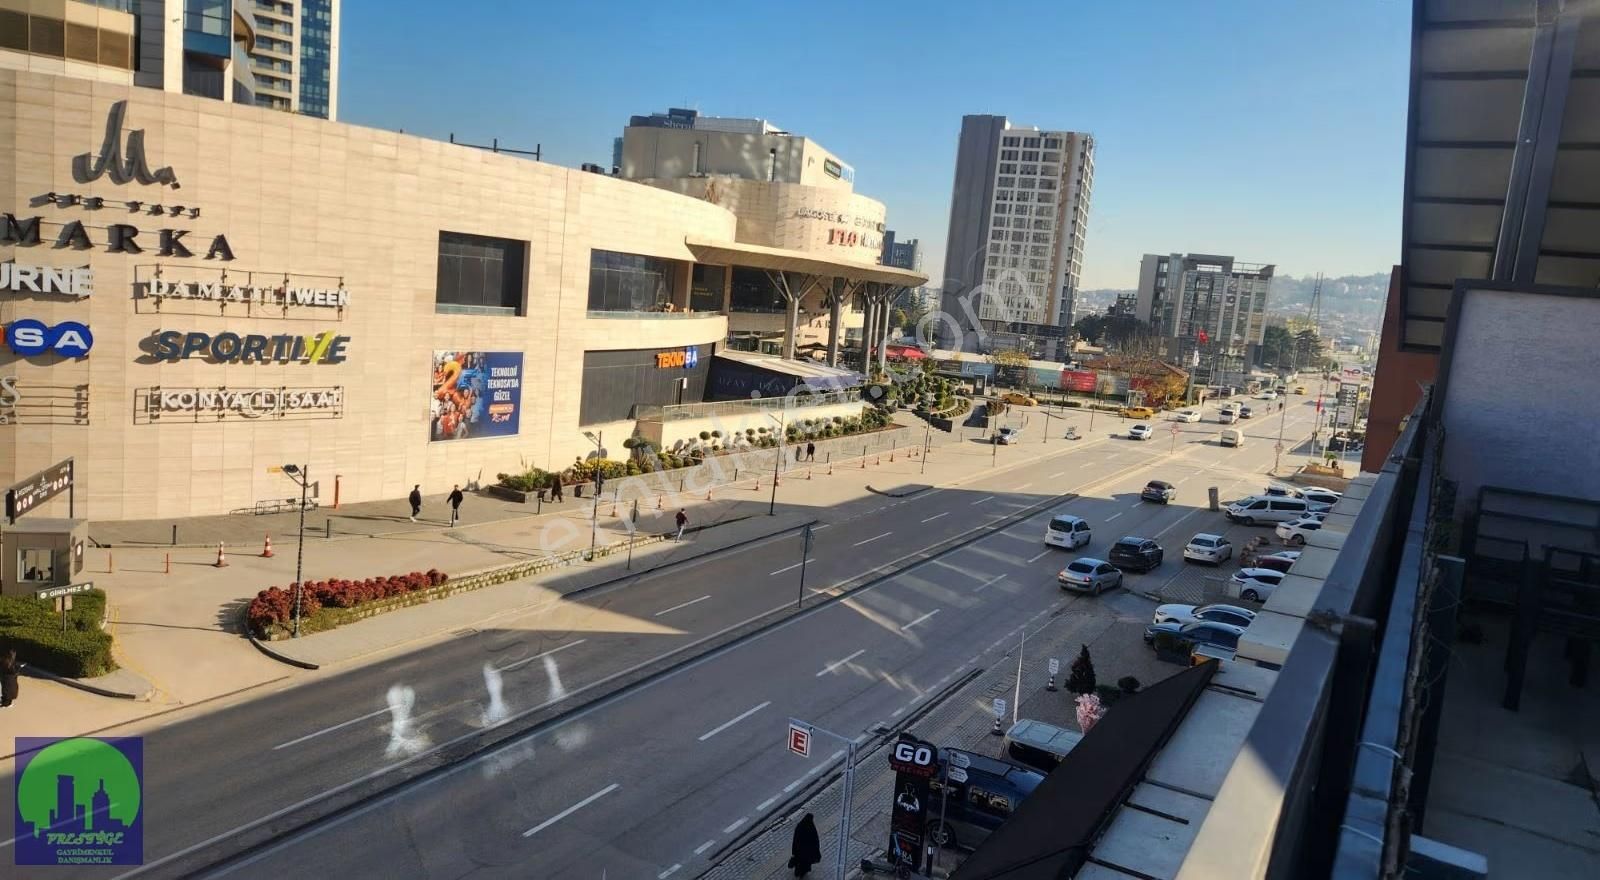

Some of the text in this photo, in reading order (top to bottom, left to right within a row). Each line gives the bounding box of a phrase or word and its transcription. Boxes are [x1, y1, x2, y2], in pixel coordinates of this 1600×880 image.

[0, 212, 237, 260] MARKA
[285, 286, 350, 306] TWEEN
[0, 326, 88, 350] SA
[155, 329, 350, 364] SPORTIVE
[657, 348, 698, 368] TEKNOSA
[50, 586, 82, 597] GİRİLMEZ
[792, 731, 808, 752] E
[895, 743, 932, 766] GO
